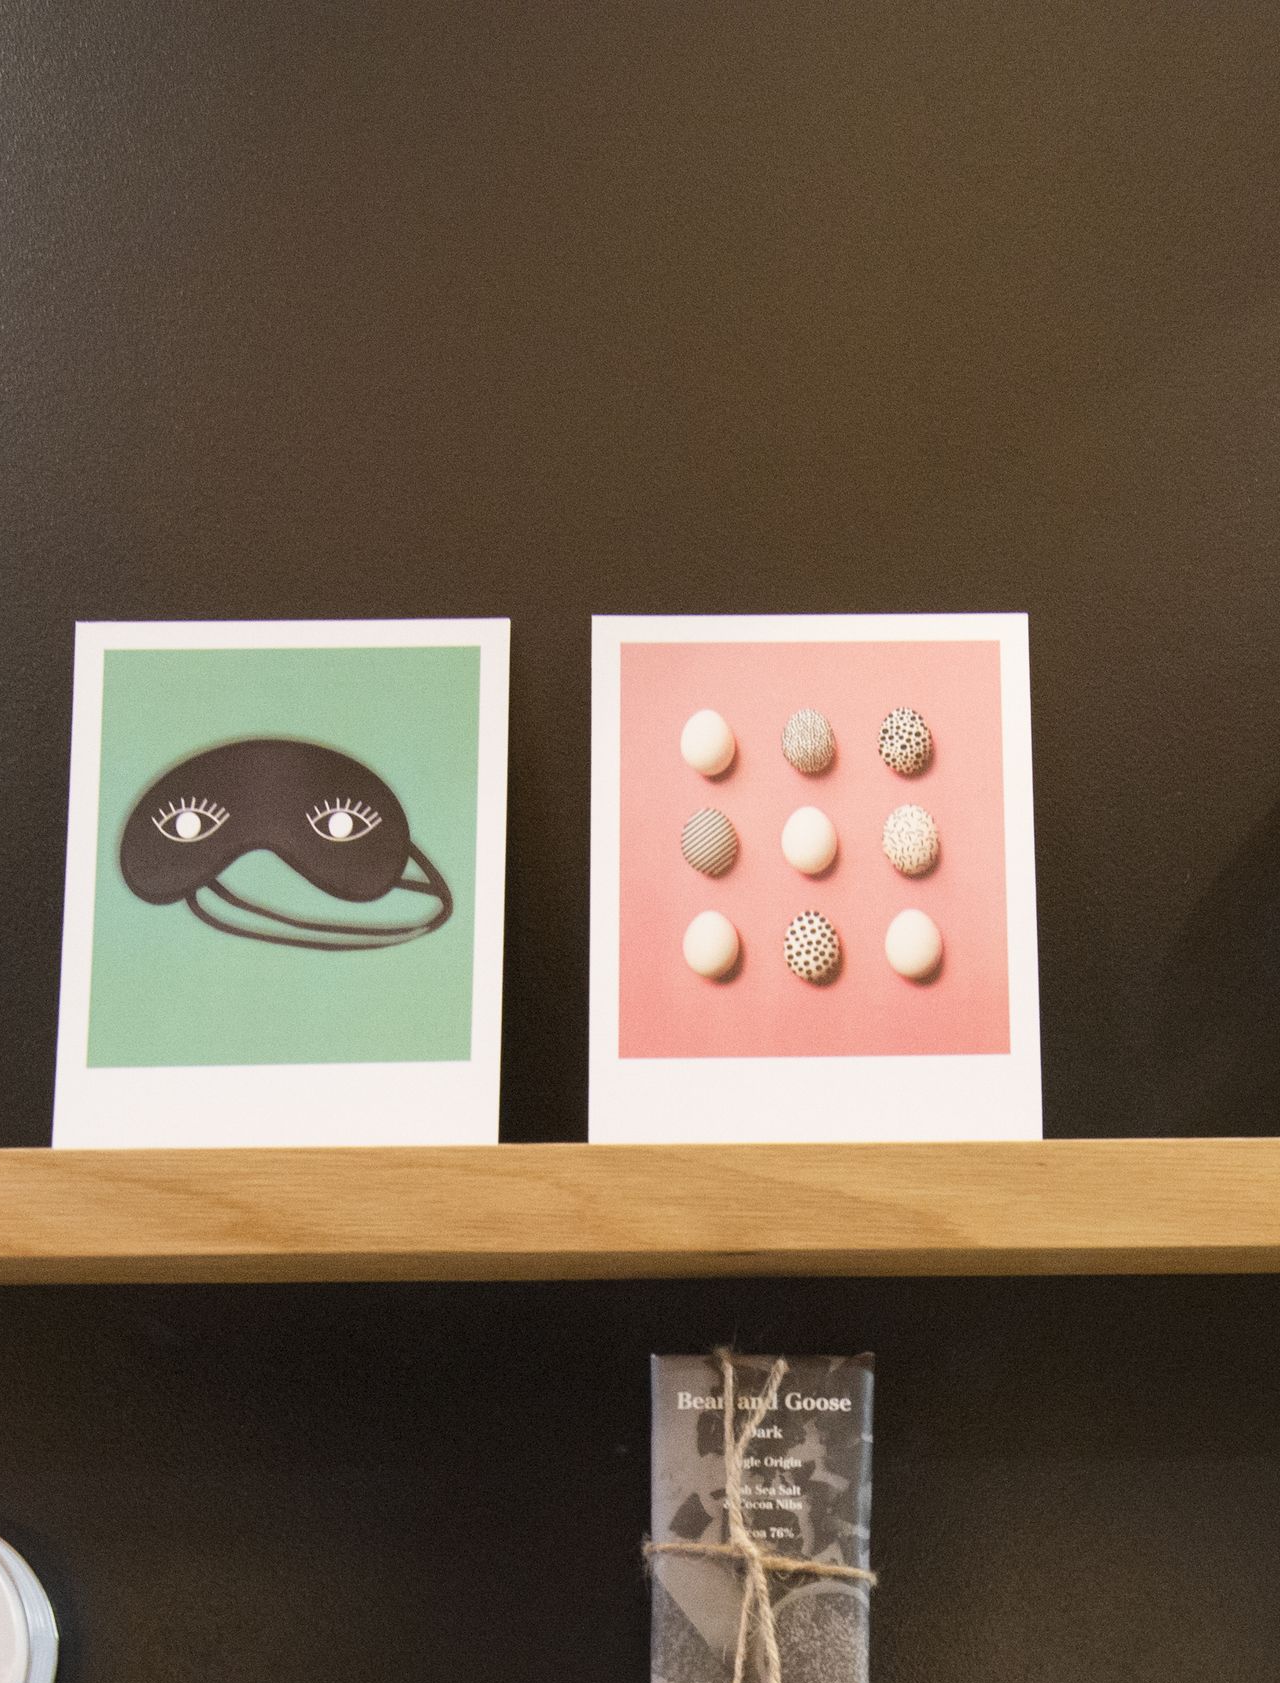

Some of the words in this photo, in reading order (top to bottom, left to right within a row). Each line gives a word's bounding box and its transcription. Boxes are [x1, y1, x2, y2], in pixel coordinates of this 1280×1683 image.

[784, 1391, 852, 1412] Goose
[753, 1425, 783, 1439] ark
[764, 1456, 802, 1470] Origin
[779, 1484, 801, 1497] Salt
[740, 1499, 773, 1511] ocoa
[770, 1526, 795, 1540] 76%
